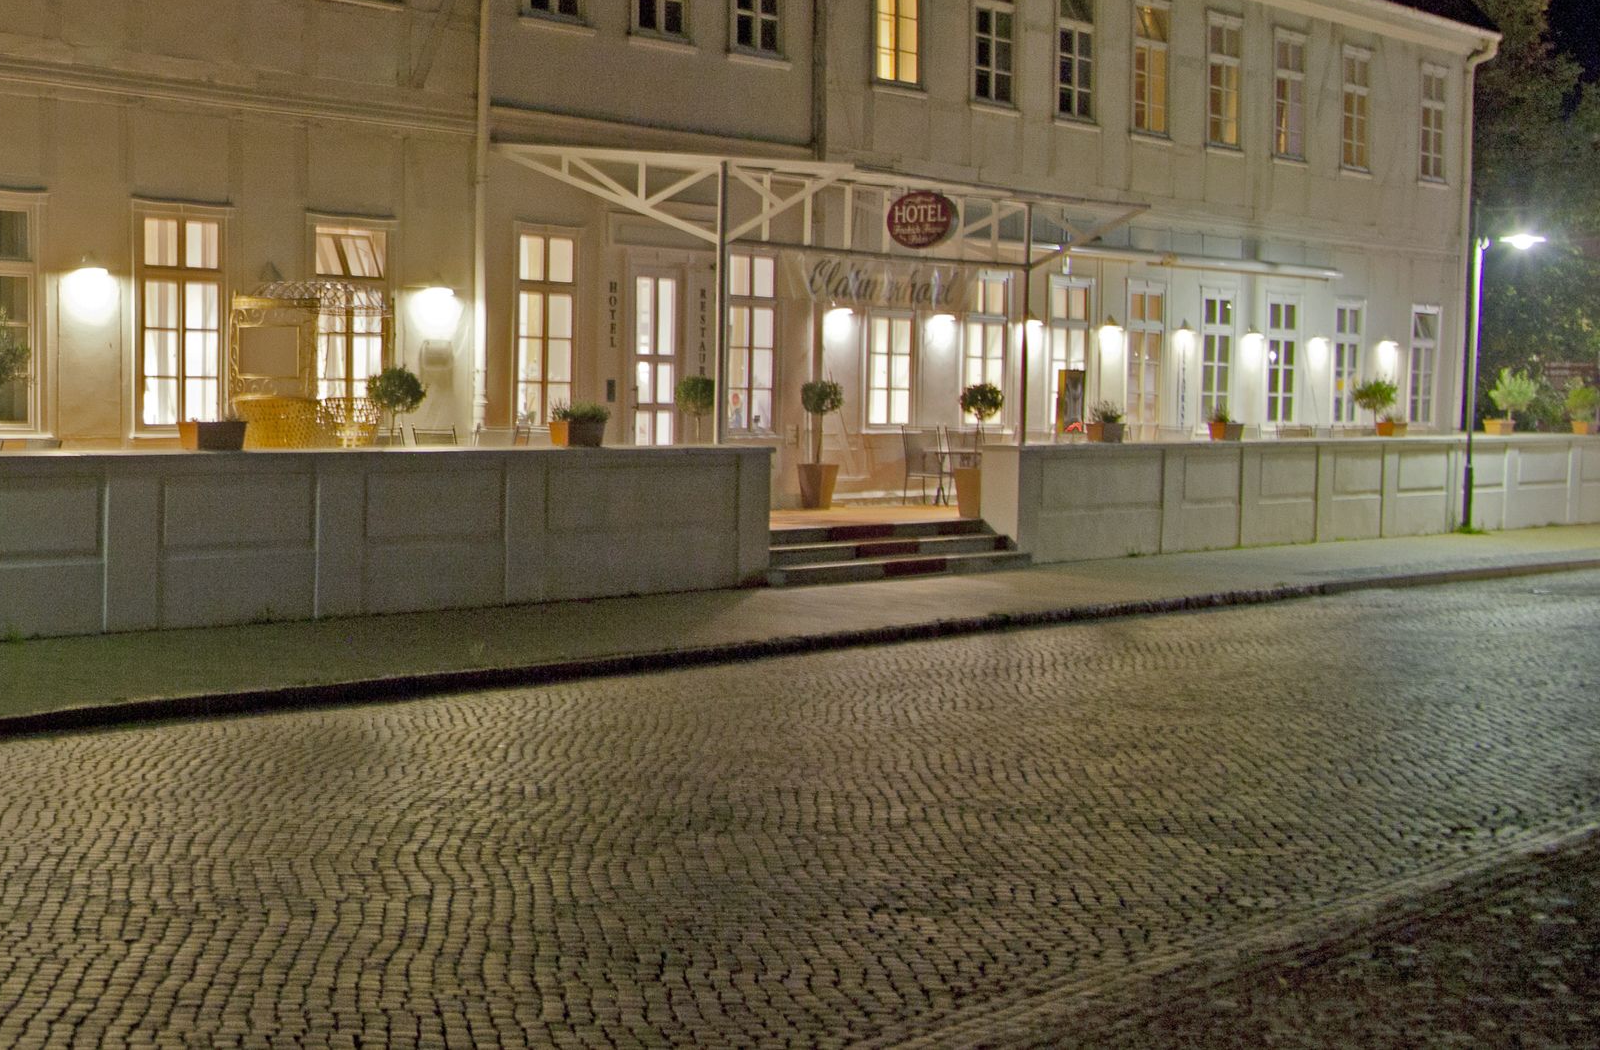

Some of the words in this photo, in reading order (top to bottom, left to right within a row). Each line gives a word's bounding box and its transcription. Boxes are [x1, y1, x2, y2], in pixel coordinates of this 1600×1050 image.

[894, 204, 947, 223] HOTEL
[608, 281, 618, 348] HOTEL
[698, 288, 707, 376] RESTAUR
